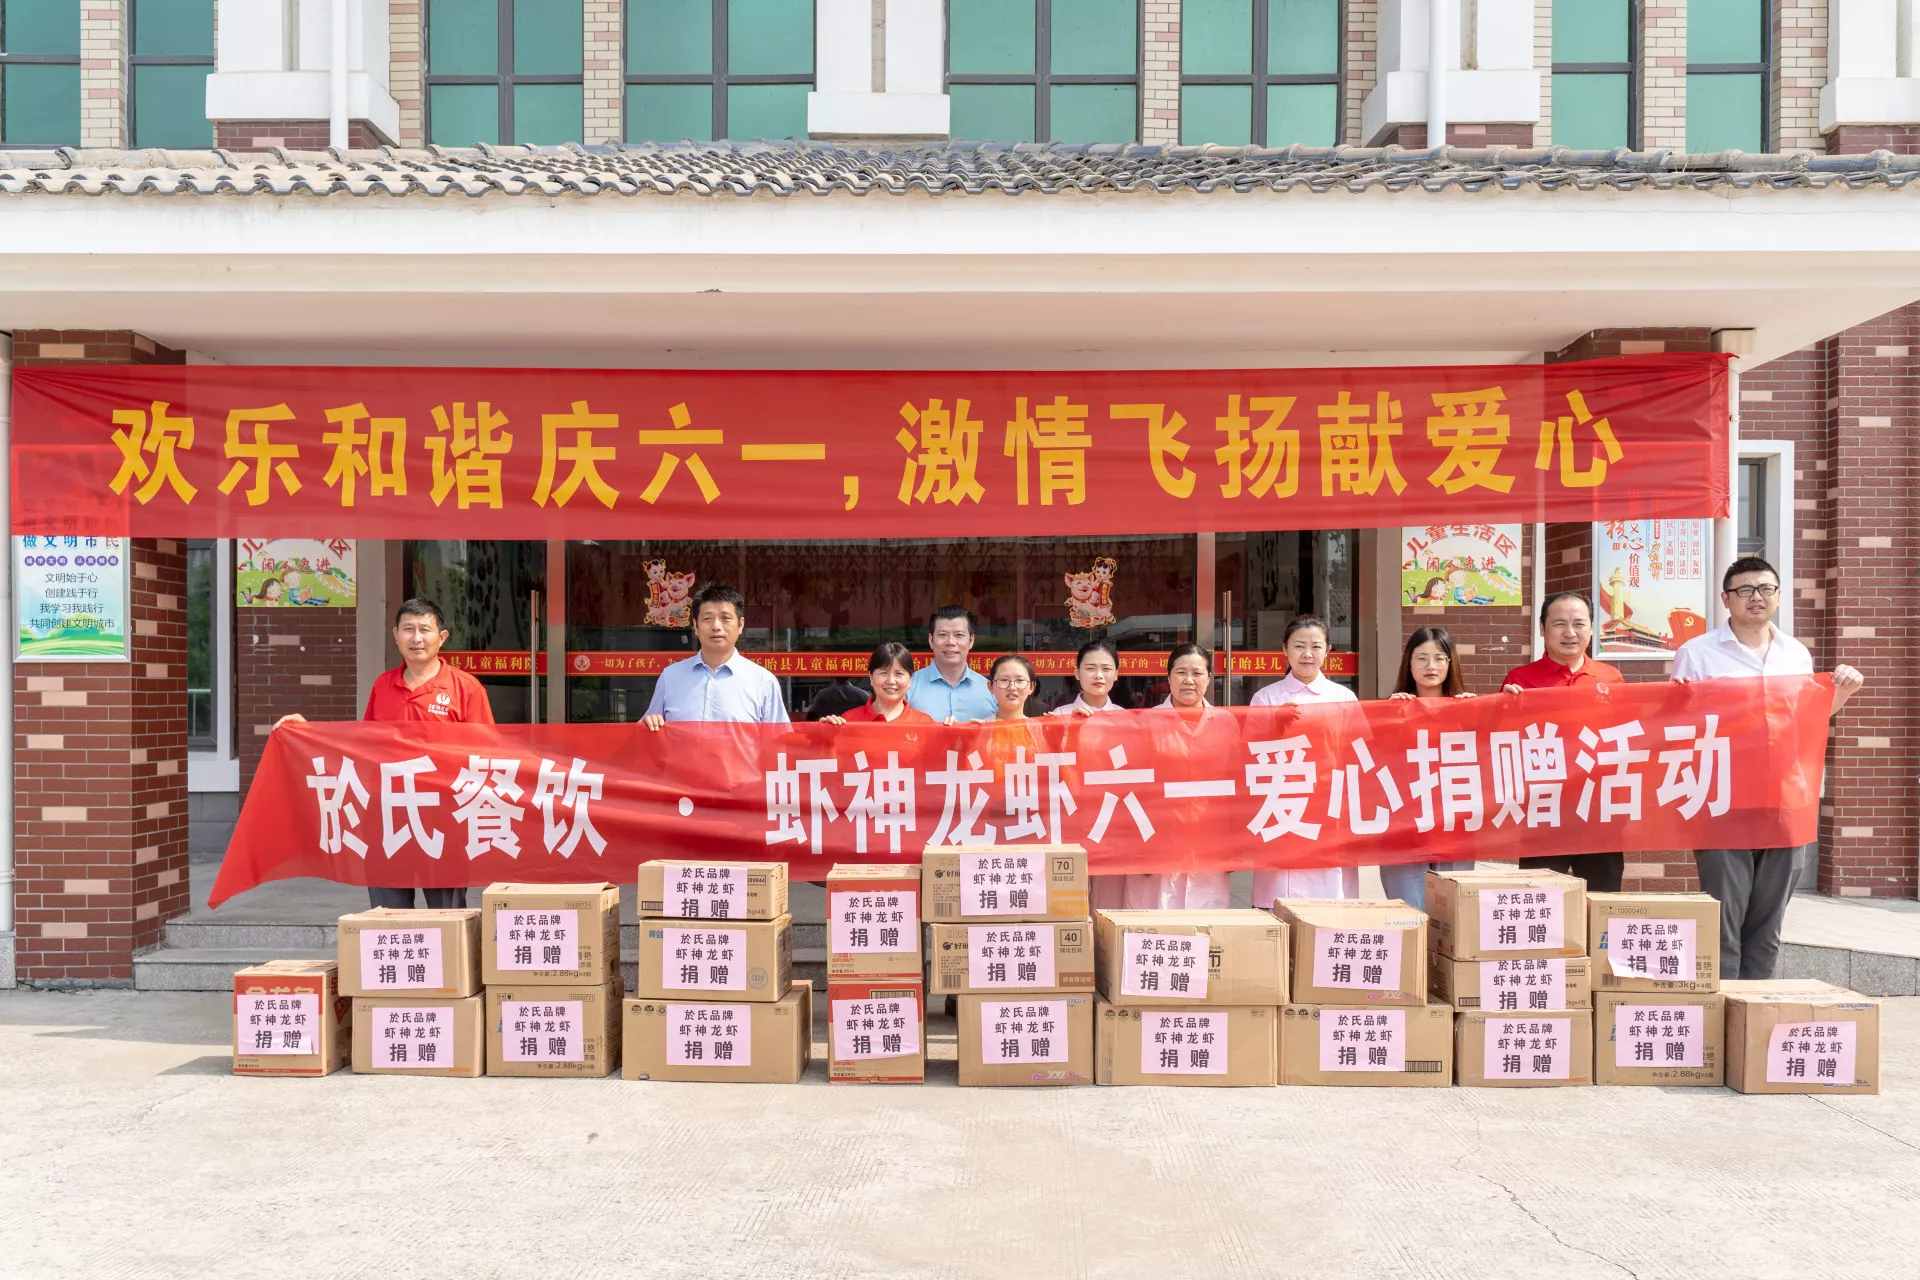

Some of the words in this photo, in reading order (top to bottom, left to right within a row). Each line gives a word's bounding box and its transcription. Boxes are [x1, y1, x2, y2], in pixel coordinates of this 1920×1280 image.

[261, 557, 332, 573] 闲人免进
[1426, 555, 1496, 572] 闲人免进
[1629, 553, 1640, 588] 价值观
[45, 573, 98, 583] 文明始于心
[45, 588, 98, 598] 创建践于行
[40, 603, 104, 613] 我学习我践行
[30, 618, 115, 629] 共同创建文明城市
[306, 755, 608, 860] 於氏餐饮
[764, 715, 1731, 856] 虾神龙虾六一爱心捐赠活动
[977, 857, 1029, 870] 於氏品牌
[1056, 861, 1070, 871] 70
[681, 867, 731, 880] 於氏品牌
[973, 872, 1033, 886] 虾神龙虾
[676, 881, 735, 895] 虾神龙虾
[848, 896, 899, 908] 於氏品牌
[978, 888, 1029, 910] 捐赠
[1496, 892, 1547, 905] 於氏品牌
[680, 897, 731, 919] 捐赠
[1492, 907, 1552, 921] 虾神龙虾
[513, 914, 562, 926] 於氏品牌
[844, 911, 904, 924] 虾神龙虾
[509, 928, 566, 941] 虾神龙虾
[985, 930, 1037, 943] 於氏品牌
[1497, 923, 1547, 945] 捐赠
[1626, 923, 1679, 936] 於氏品牌
[377, 933, 425, 945] 於氏品牌
[680, 933, 730, 946] 於氏品牌
[849, 927, 899, 948] 捐赠
[1064, 932, 1078, 942] 40
[1333, 932, 1385, 946] 於氏品牌
[981, 945, 1042, 959] 虾神龙虾
[1141, 938, 1192, 952] 於氏品牌
[1621, 938, 1683, 952] 虾神龙虾
[373, 947, 430, 961] 虾神龙虾
[514, 944, 562, 965] 捐赠
[675, 948, 734, 961] 虾神龙虾
[1135, 953, 1196, 968] 虾神龙虾
[1327, 947, 1389, 961] 虾神龙虾
[986, 961, 1037, 982] 捐赠
[1497, 960, 1548, 971] 於氏品牌
[378, 963, 426, 984] 捐赠
[680, 964, 729, 985] 捐赠
[1332, 963, 1383, 985] 捐赠
[1493, 973, 1553, 987] 虾神龙虾
[1140, 970, 1190, 993] 捐赠
[254, 999, 302, 1011] 於氏品牌
[1498, 989, 1548, 1010] 捐赠
[518, 1006, 566, 1018] 於氏品牌
[684, 1009, 734, 1021] 於氏品牌
[850, 1002, 901, 1016] 於氏品牌
[999, 1005, 1050, 1019] 於氏品牌
[1633, 1010, 1686, 1022] 於氏品牌
[249, 1013, 307, 1026] 虾神龙虾
[389, 1012, 437, 1024] 於氏品牌
[846, 1016, 906, 1031] 虾神龙虾
[1159, 1016, 1210, 1029] 於氏品牌
[1337, 1014, 1388, 1027] 於氏品牌
[384, 1026, 441, 1039] 虾神龙虾
[514, 1020, 571, 1033] 虾神龙虾
[679, 1024, 739, 1037] 虾神龙虾
[995, 1020, 1055, 1034] 虾神龙虾
[1502, 1023, 1553, 1035] 於氏品牌
[1629, 1024, 1691, 1038] 虾神龙虾
[1788, 1026, 1839, 1038] 於氏品牌
[255, 1029, 302, 1049] 捐赠
[1154, 1031, 1215, 1045] 虾神龙虾
[1332, 1029, 1393, 1042] 虾神龙虾
[519, 1036, 567, 1056] 捐赠
[684, 1040, 733, 1061] 捐赠
[852, 1033, 902, 1054] 捐赠
[1000, 1037, 1051, 1058] 捐赠
[1497, 1037, 1558, 1050] 虾神龙虾
[1781, 1040, 1843, 1054] 虾神龙虾
[389, 1042, 437, 1063] 捐赠
[1159, 1048, 1210, 1069] 捐赠
[1337, 1045, 1388, 1066] 捐赠
[1634, 1041, 1685, 1062] 捐赠
[1502, 1053, 1552, 1074] 捐赠
[1786, 1057, 1837, 1078] 捐赠
